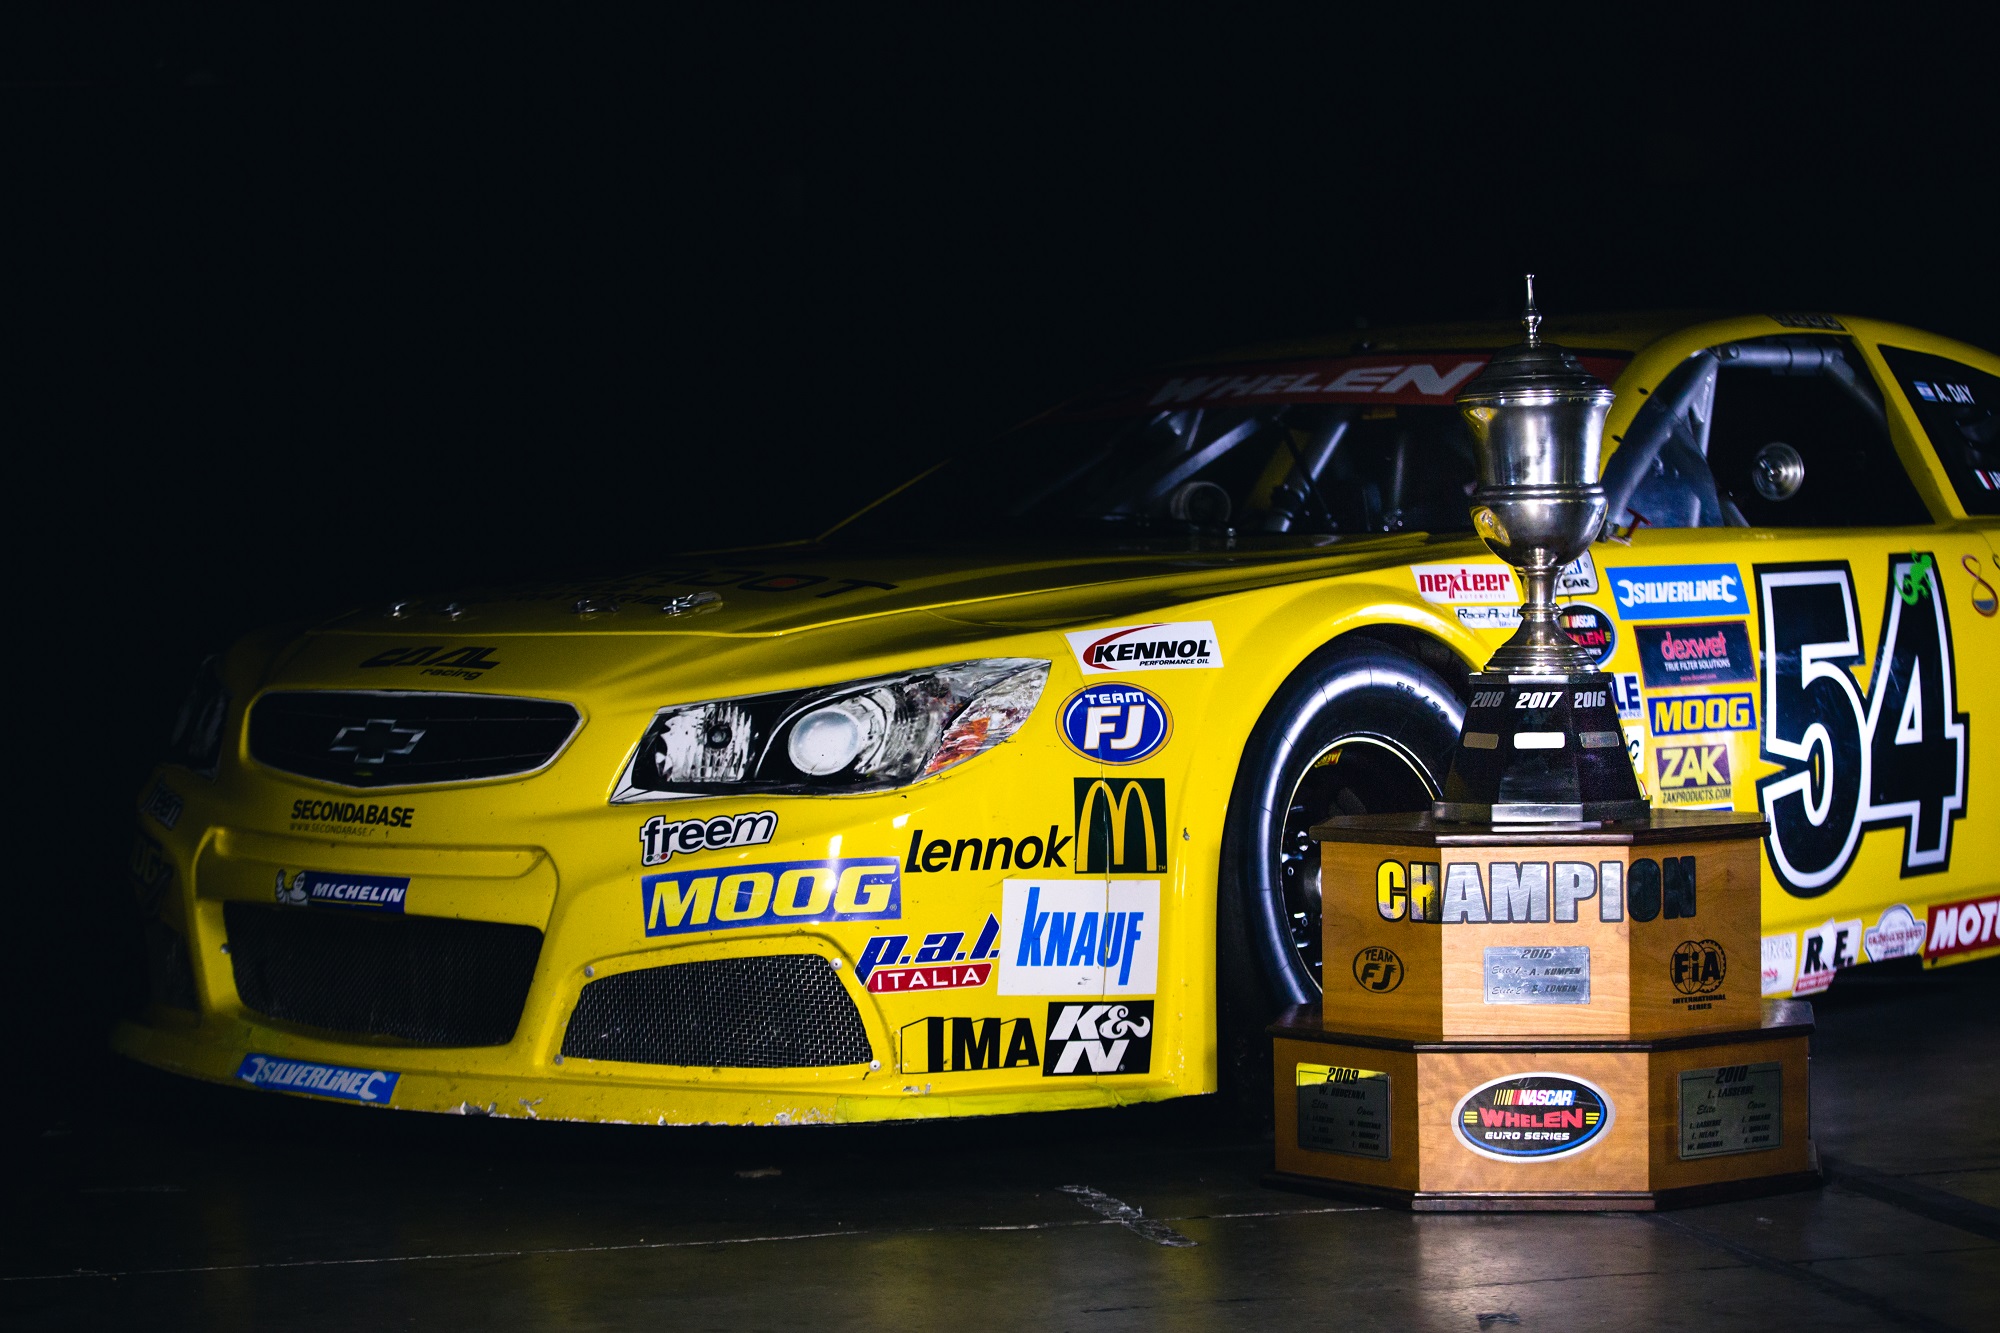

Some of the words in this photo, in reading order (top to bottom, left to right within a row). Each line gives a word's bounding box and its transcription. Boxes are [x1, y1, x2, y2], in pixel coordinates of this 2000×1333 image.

[1149, 361, 1488, 406] WHELEN
[1419, 569, 1510, 599] nexteer
[1094, 640, 1210, 663] KENNOL
[1661, 630, 1728, 661] dexwet
[1139, 658, 1195, 666] PERFORMANCE
[1664, 661, 1681, 672] TRUE
[420, 668, 483, 681] racing
[1085, 691, 1145, 705] TEAM
[1470, 691, 1505, 708] 2018
[1514, 691, 1563, 709] 2017
[1574, 691, 1606, 708] 2016
[1654, 697, 1750, 733] MOOG
[1752, 552, 1969, 898] 54
[1083, 704, 1147, 751] FJ
[1660, 745, 1726, 788] ZAK
[291, 799, 415, 828] SECONDABASE
[644, 815, 773, 860] freem
[312, 881, 405, 903] MICHELIN
[648, 864, 896, 930] MOOG
[1375, 856, 1697, 923] CHAMPION
[1016, 886, 1144, 986] KNAUF
[1928, 900, 2000, 952] MOT
[1365, 949, 1393, 962] TEAM
[1521, 948, 1553, 959] 2016
[876, 967, 981, 990] ITALIA
[1361, 963, 1397, 990] FJ
[1545, 984, 1578, 993] LONGIN
[1672, 994, 1726, 1004] INTERNATIONAL
[1688, 1003, 1712, 1011] SERIES
[901, 1017, 1040, 1074] IMA
[1327, 1067, 1359, 1085] 2009
[1716, 1066, 1748, 1084] 2010
[1519, 1090, 1573, 1105] NASCAR
[1479, 1108, 1583, 1129] WHELEN
[1697, 1104, 1716, 1115] Elite
[1485, 1131, 1521, 1140] EURO
[1524, 1132, 1570, 1141] SERIES
